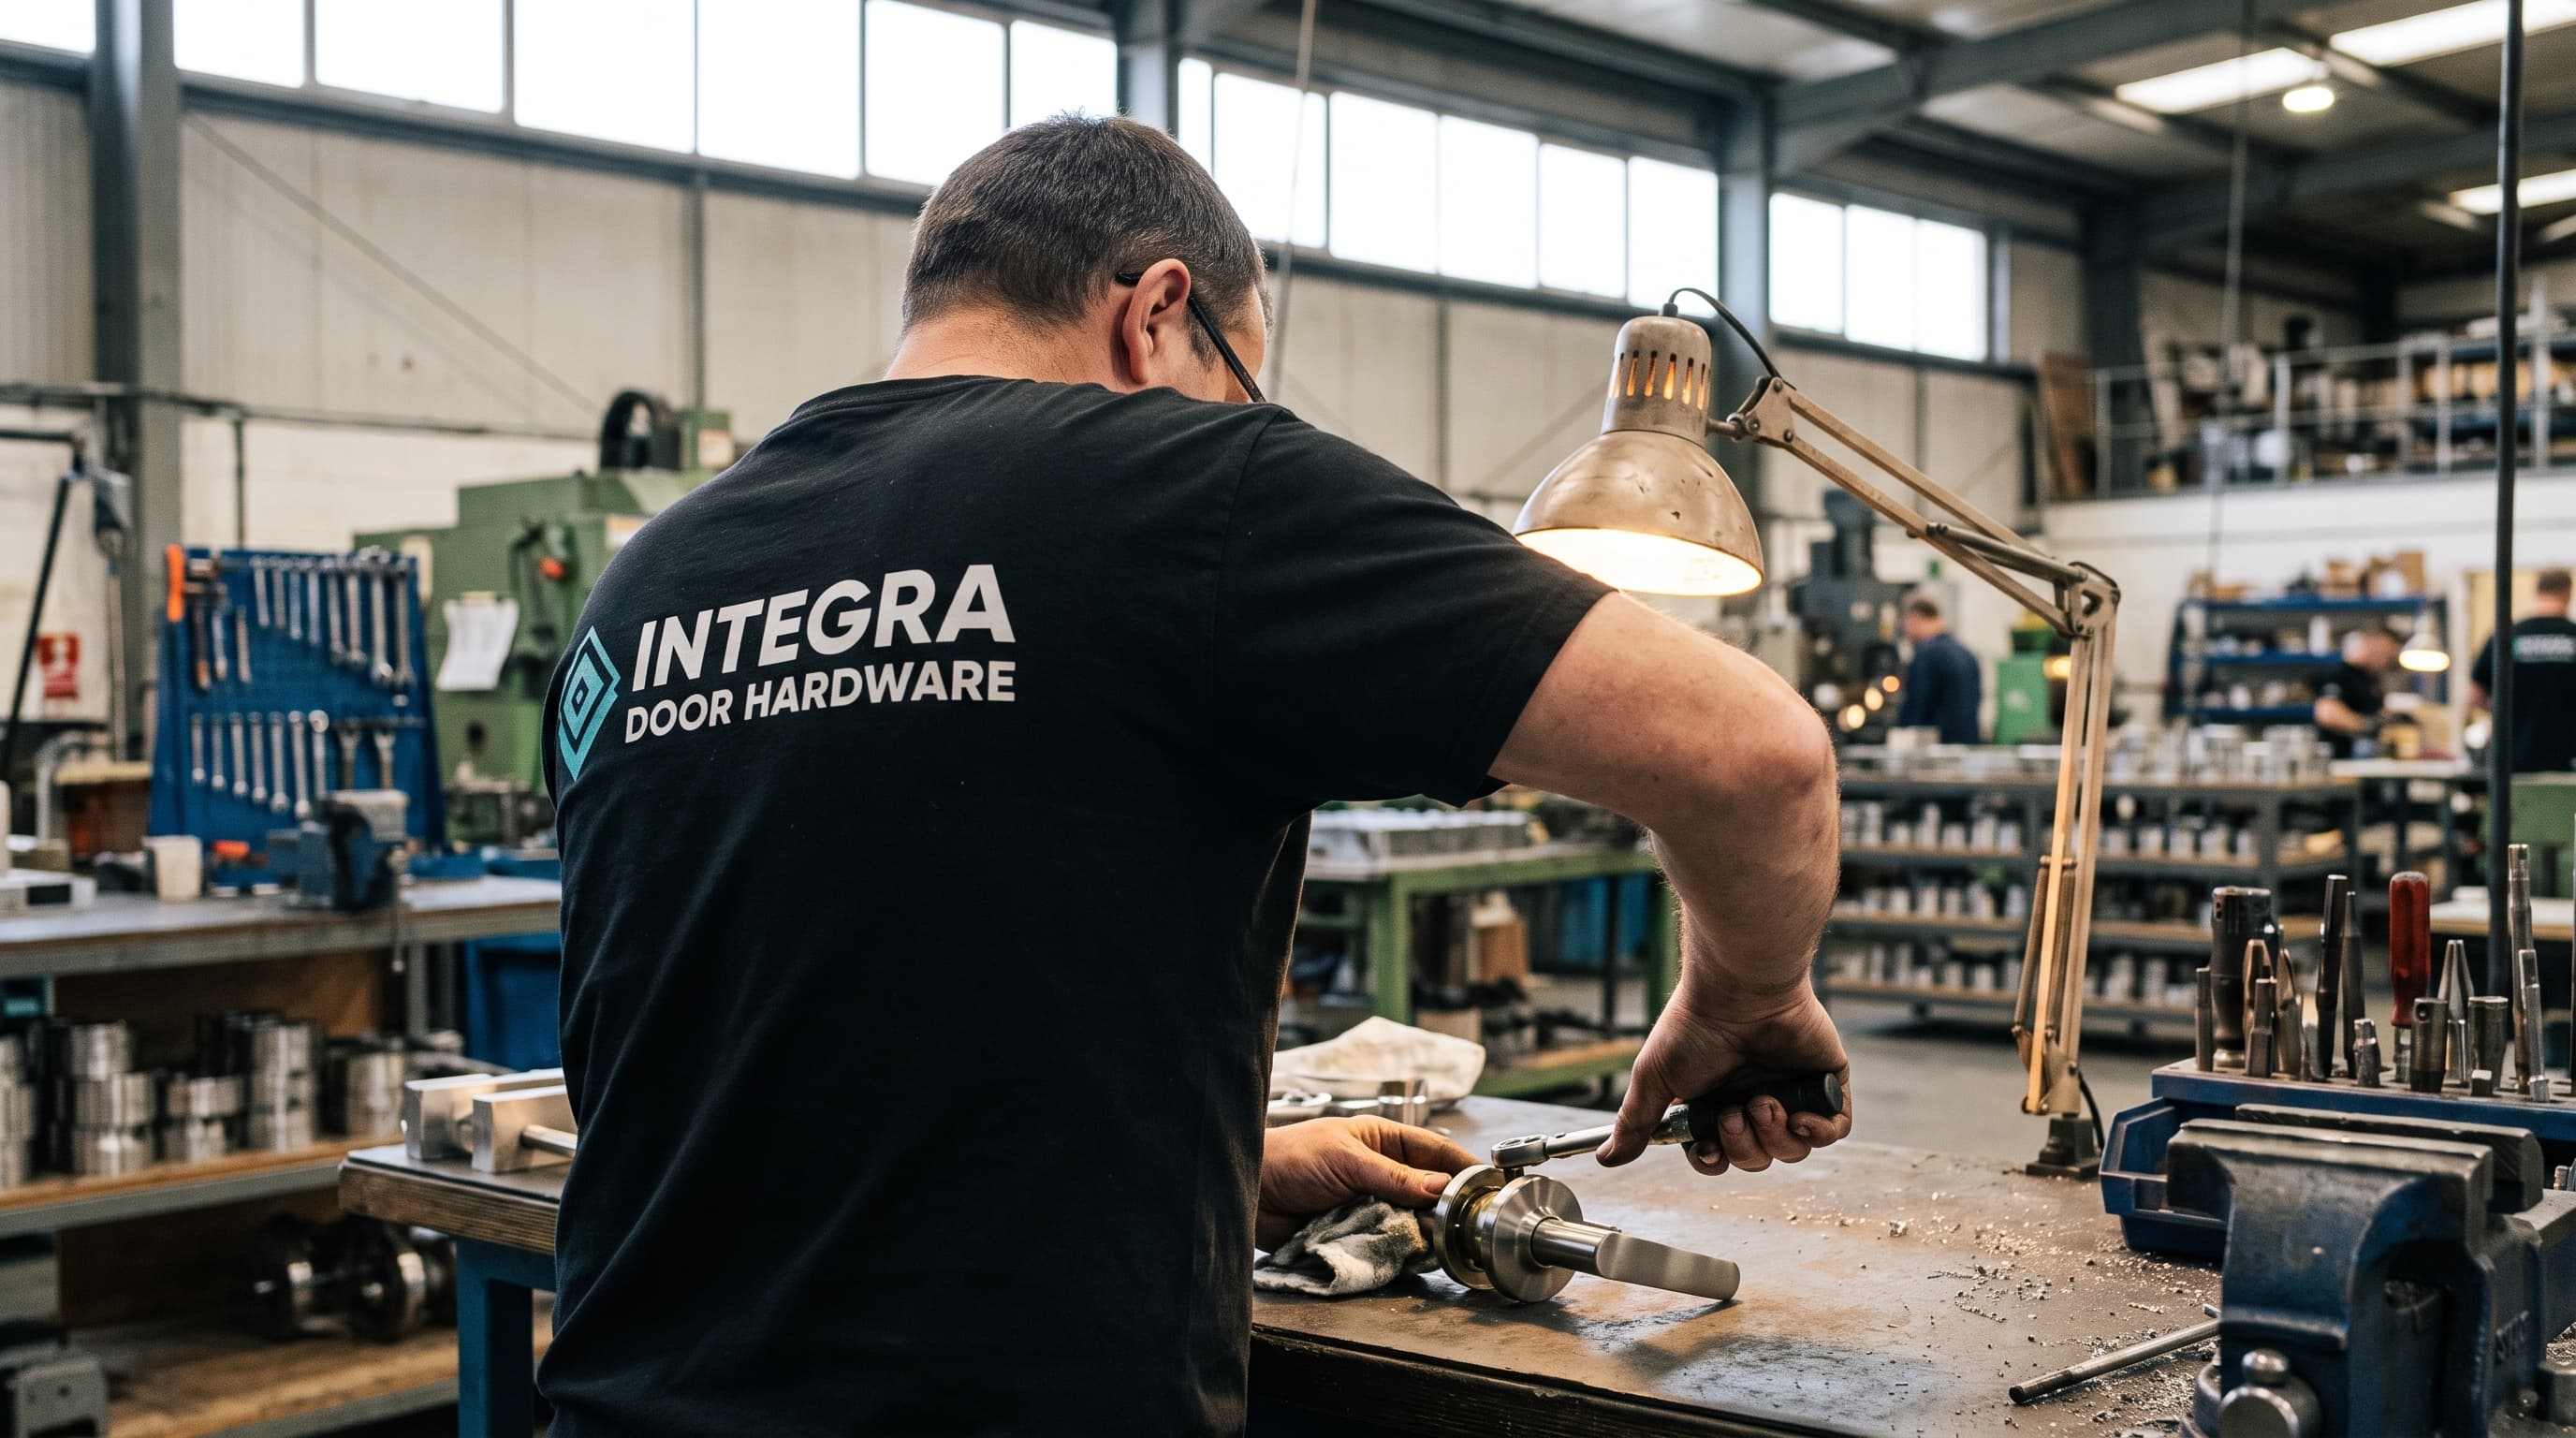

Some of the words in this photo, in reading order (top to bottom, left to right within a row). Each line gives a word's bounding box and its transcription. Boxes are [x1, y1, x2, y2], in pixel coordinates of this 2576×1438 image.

[631, 564, 1016, 692] INTEGRA
[624, 688, 734, 743] DOOR
[744, 660, 1016, 721] HARDWARE
